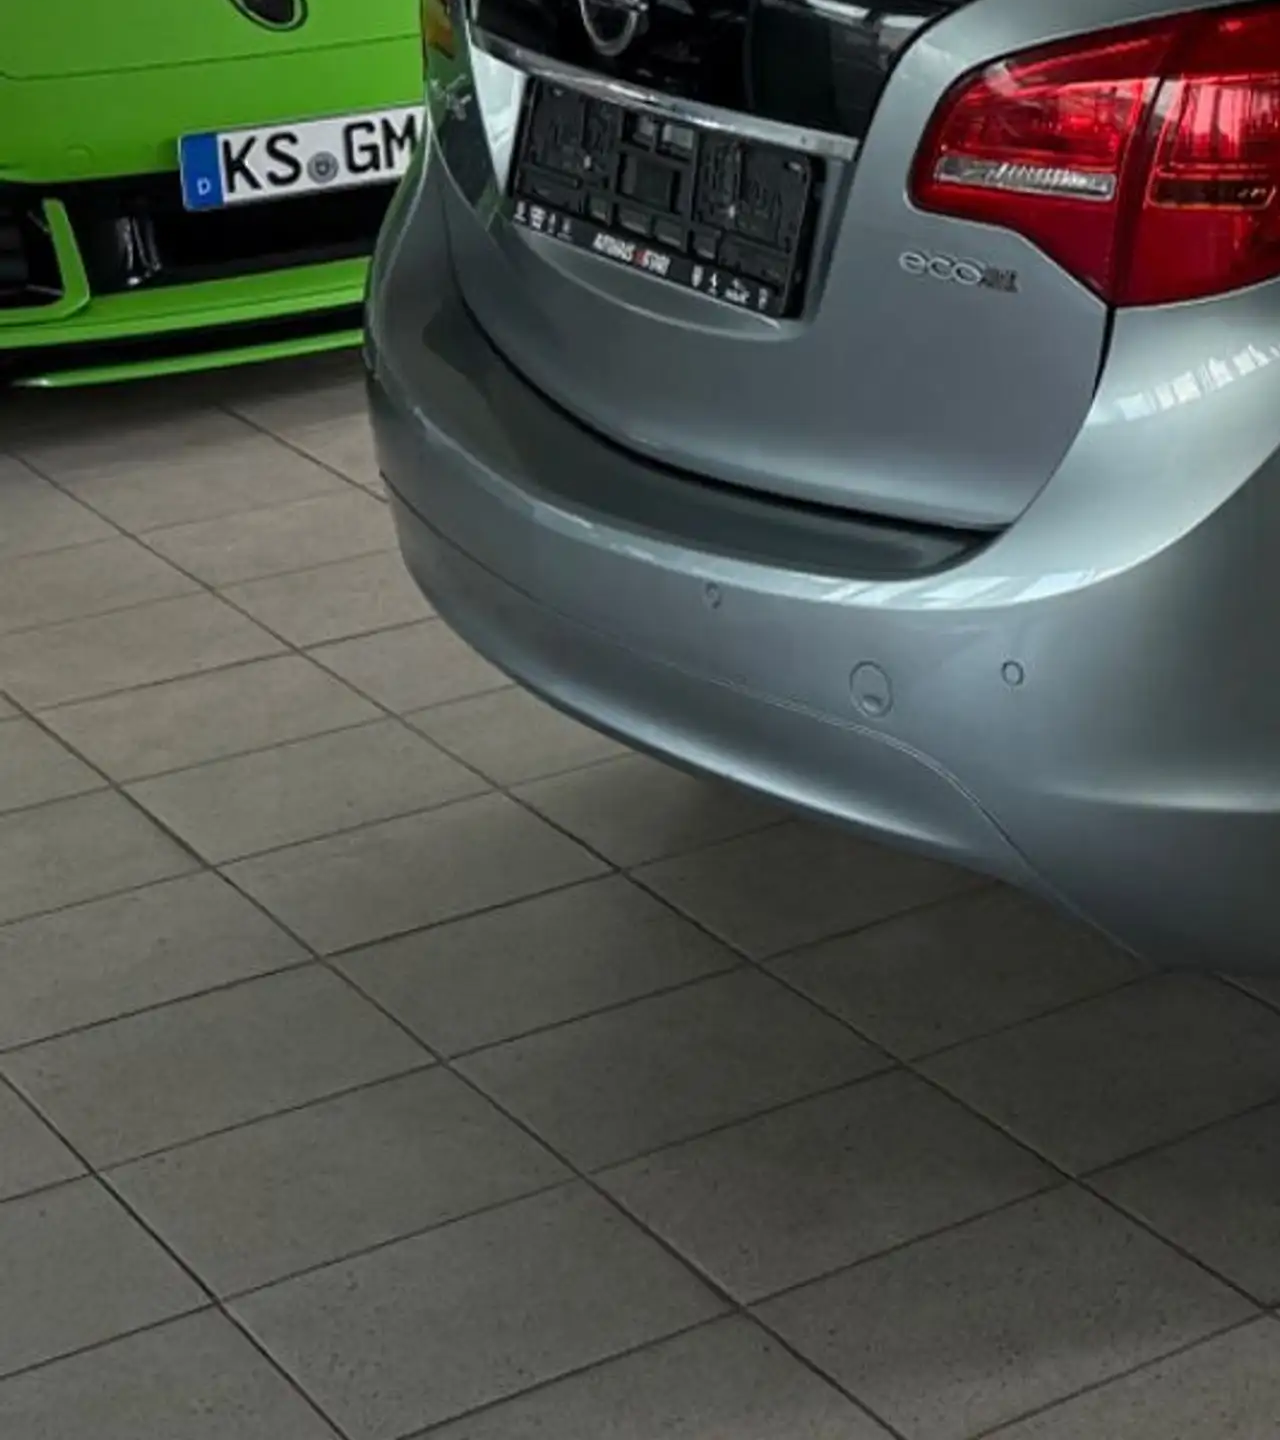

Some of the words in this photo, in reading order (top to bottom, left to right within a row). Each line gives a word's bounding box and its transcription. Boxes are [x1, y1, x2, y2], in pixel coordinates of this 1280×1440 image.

[222, 131, 302, 193] KS
[342, 113, 418, 175] GM
[197, 176, 212, 196] D
